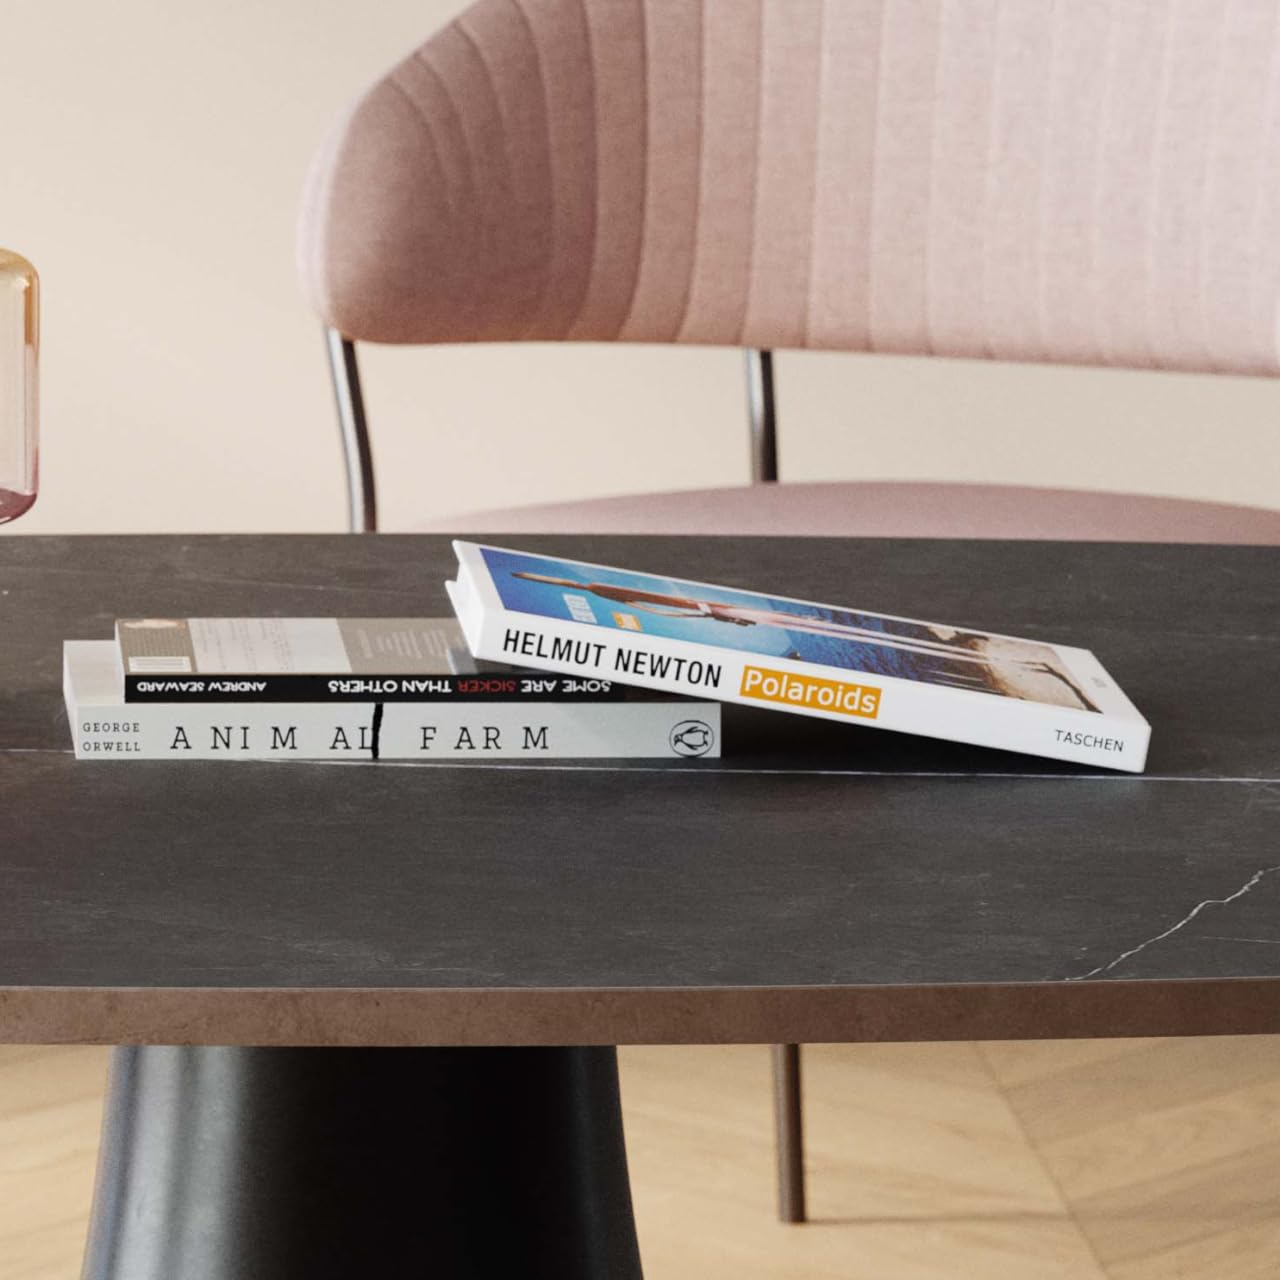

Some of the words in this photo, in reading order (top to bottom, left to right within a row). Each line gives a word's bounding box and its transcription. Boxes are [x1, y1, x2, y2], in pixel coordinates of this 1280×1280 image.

[503, 628, 607, 667] HELMUT
[614, 648, 722, 688] NEWTON
[136, 681, 206, 692] SEAWARD
[208, 681, 267, 692] ANDREW
[327, 680, 398, 694] OTHERS
[402, 680, 452, 693] THAN
[457, 680, 516, 693] SICKER
[520, 680, 558, 693] ARE
[562, 679, 612, 693] SOME
[744, 669, 876, 714] Polaroids
[82, 722, 141, 734] GEORGE
[82, 741, 141, 753] ORWELL
[1055, 729, 1124, 753] TASCHEN
